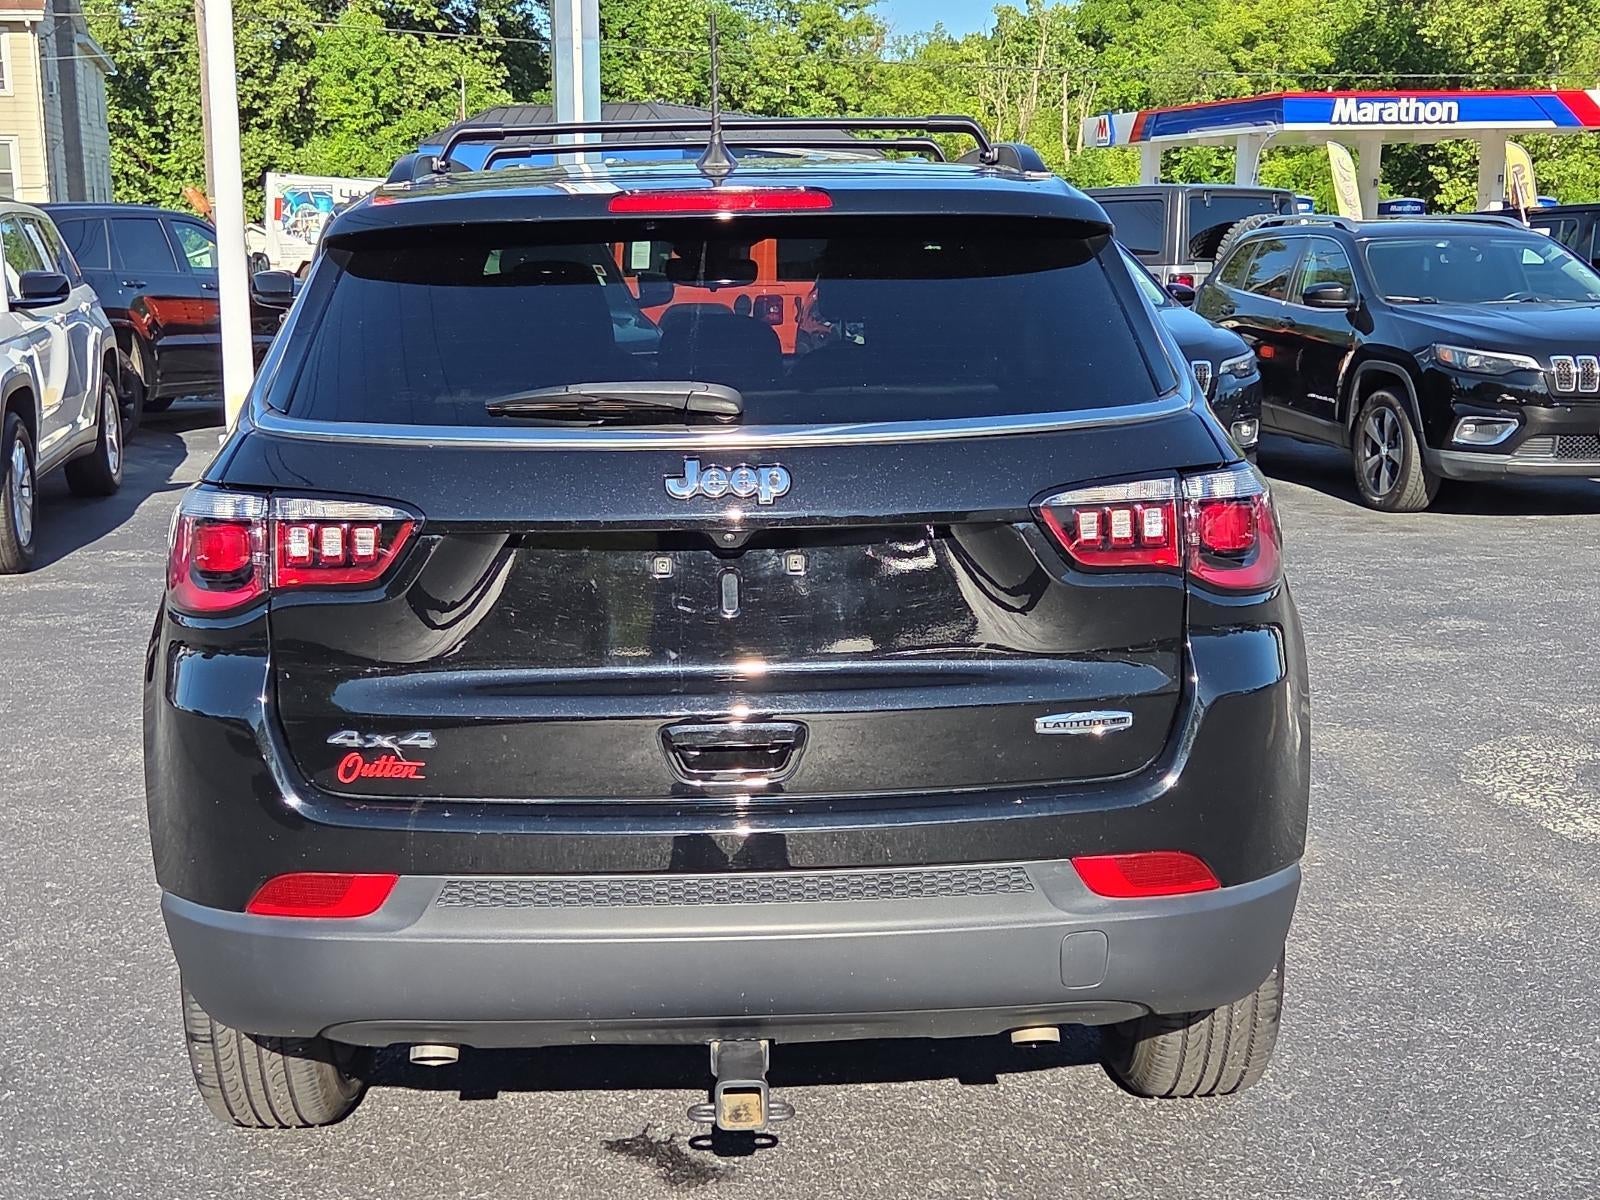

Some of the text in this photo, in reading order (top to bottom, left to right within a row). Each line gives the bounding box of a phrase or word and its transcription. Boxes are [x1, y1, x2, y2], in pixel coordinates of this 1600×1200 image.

[1331, 97, 1459, 124] Marathon
[664, 456, 792, 505] Jeep
[1043, 719, 1108, 729] LATITUDE
[337, 752, 426, 784] Outten
